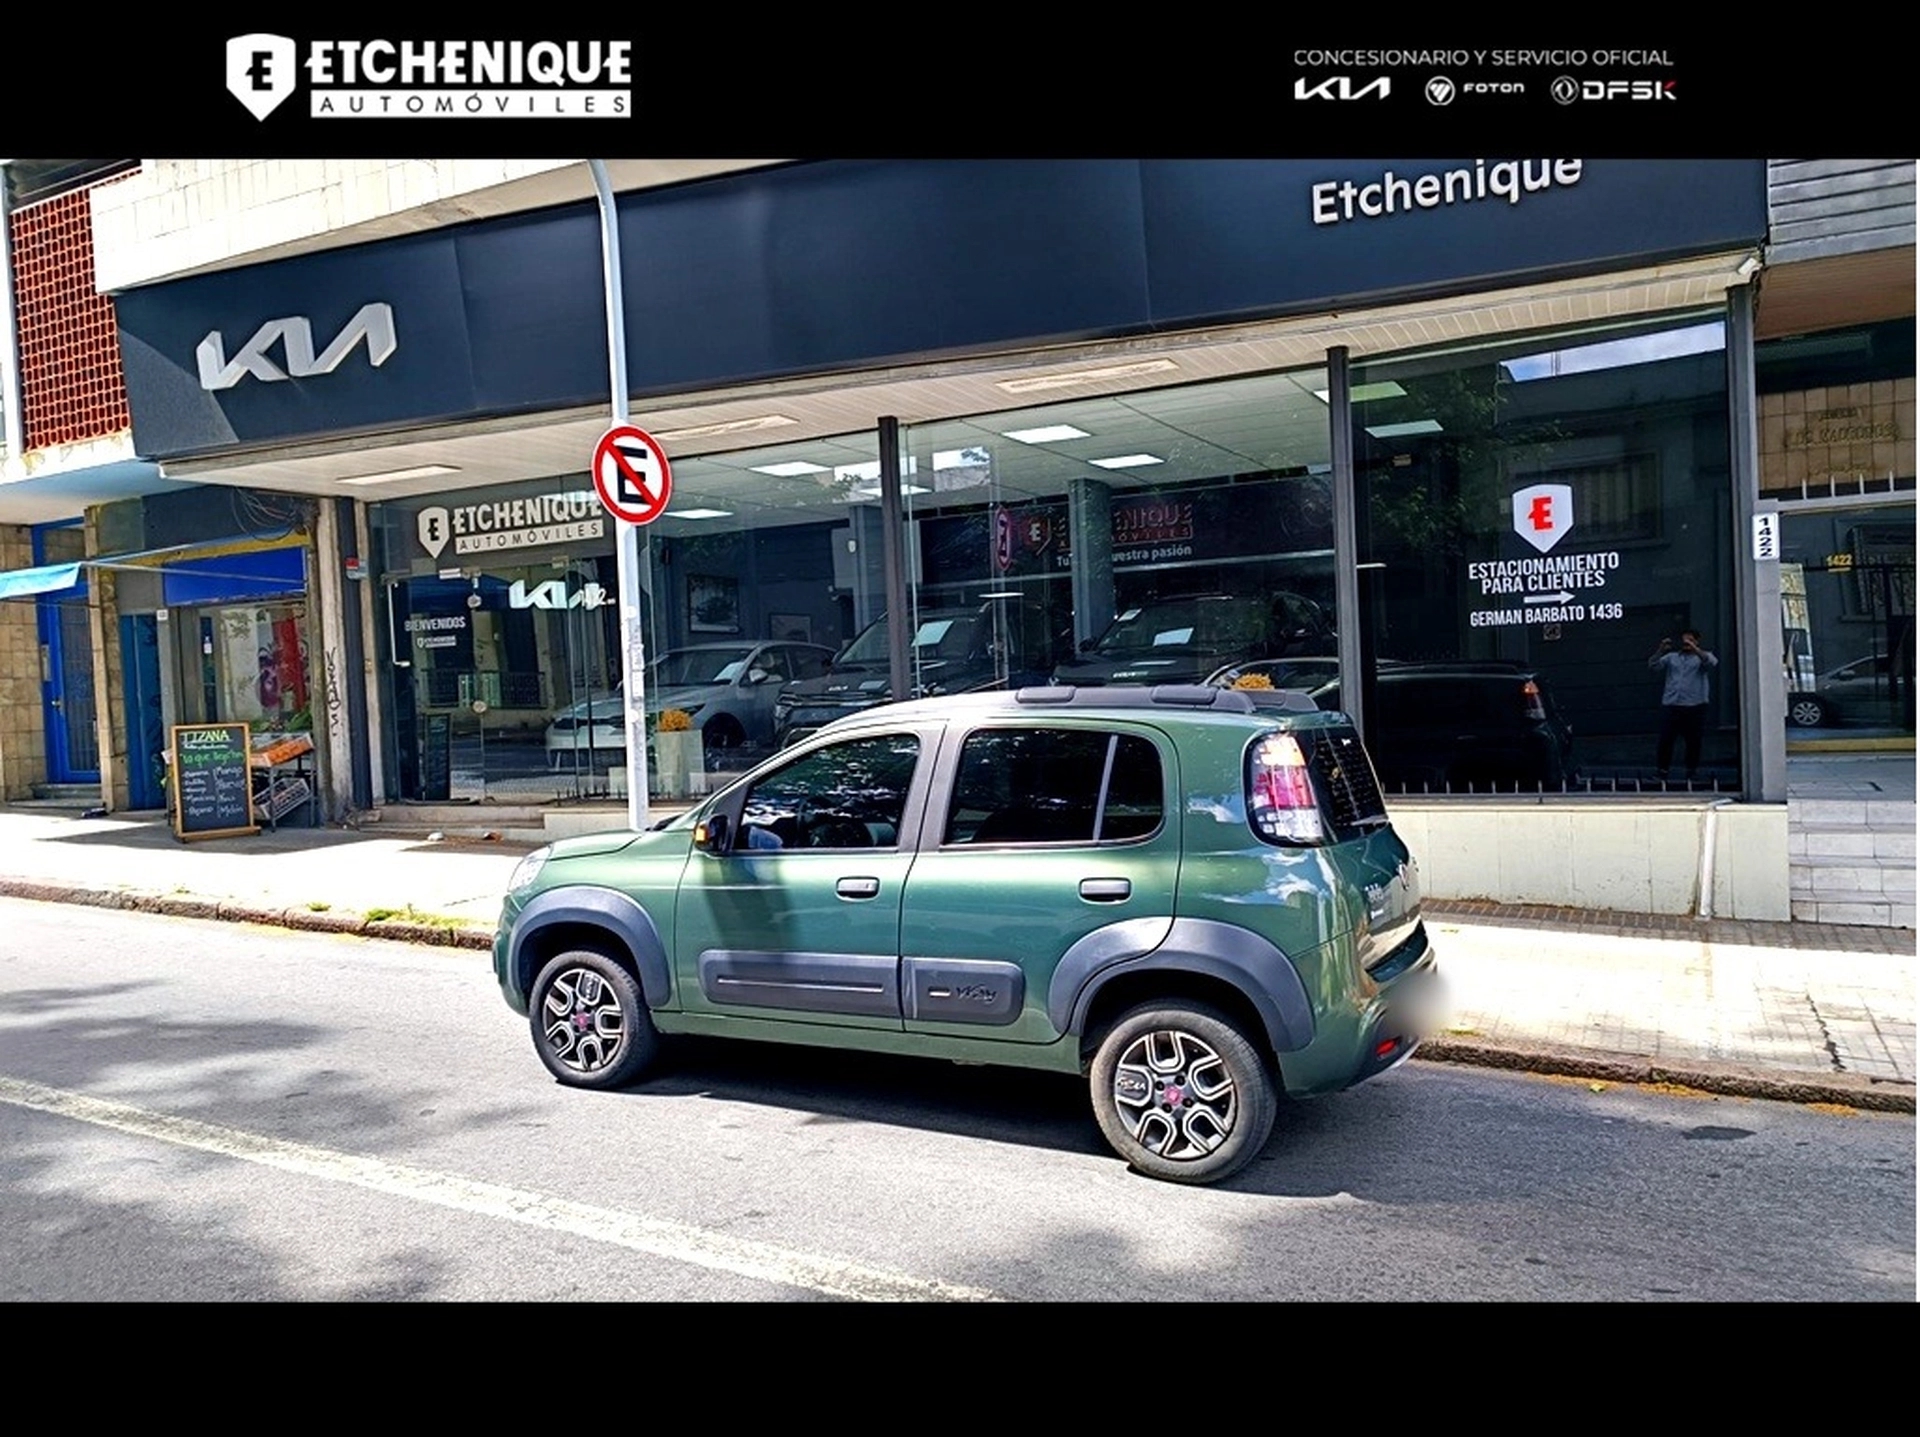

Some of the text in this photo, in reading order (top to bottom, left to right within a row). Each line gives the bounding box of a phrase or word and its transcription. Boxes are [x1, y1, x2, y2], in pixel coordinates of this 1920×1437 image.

[1312, 159, 1583, 224] Etchenique
[196, 302, 398, 391] KIA
[615, 445, 649, 506] E
[451, 493, 603, 535] ETCHENIQUE
[459, 522, 599, 551] AUTOMÓVILES
[1758, 517, 1773, 557] 1422
[1151, 544, 1192, 560] pasión
[1468, 552, 1620, 580] ESTACIONAMIENTO
[1826, 554, 1853, 566] 1422
[1482, 570, 1606, 595] PARA CLIENTES
[404, 616, 467, 632] BIENVENIDOS
[1470, 603, 1623, 627] GERMAN BARBATO 1436
